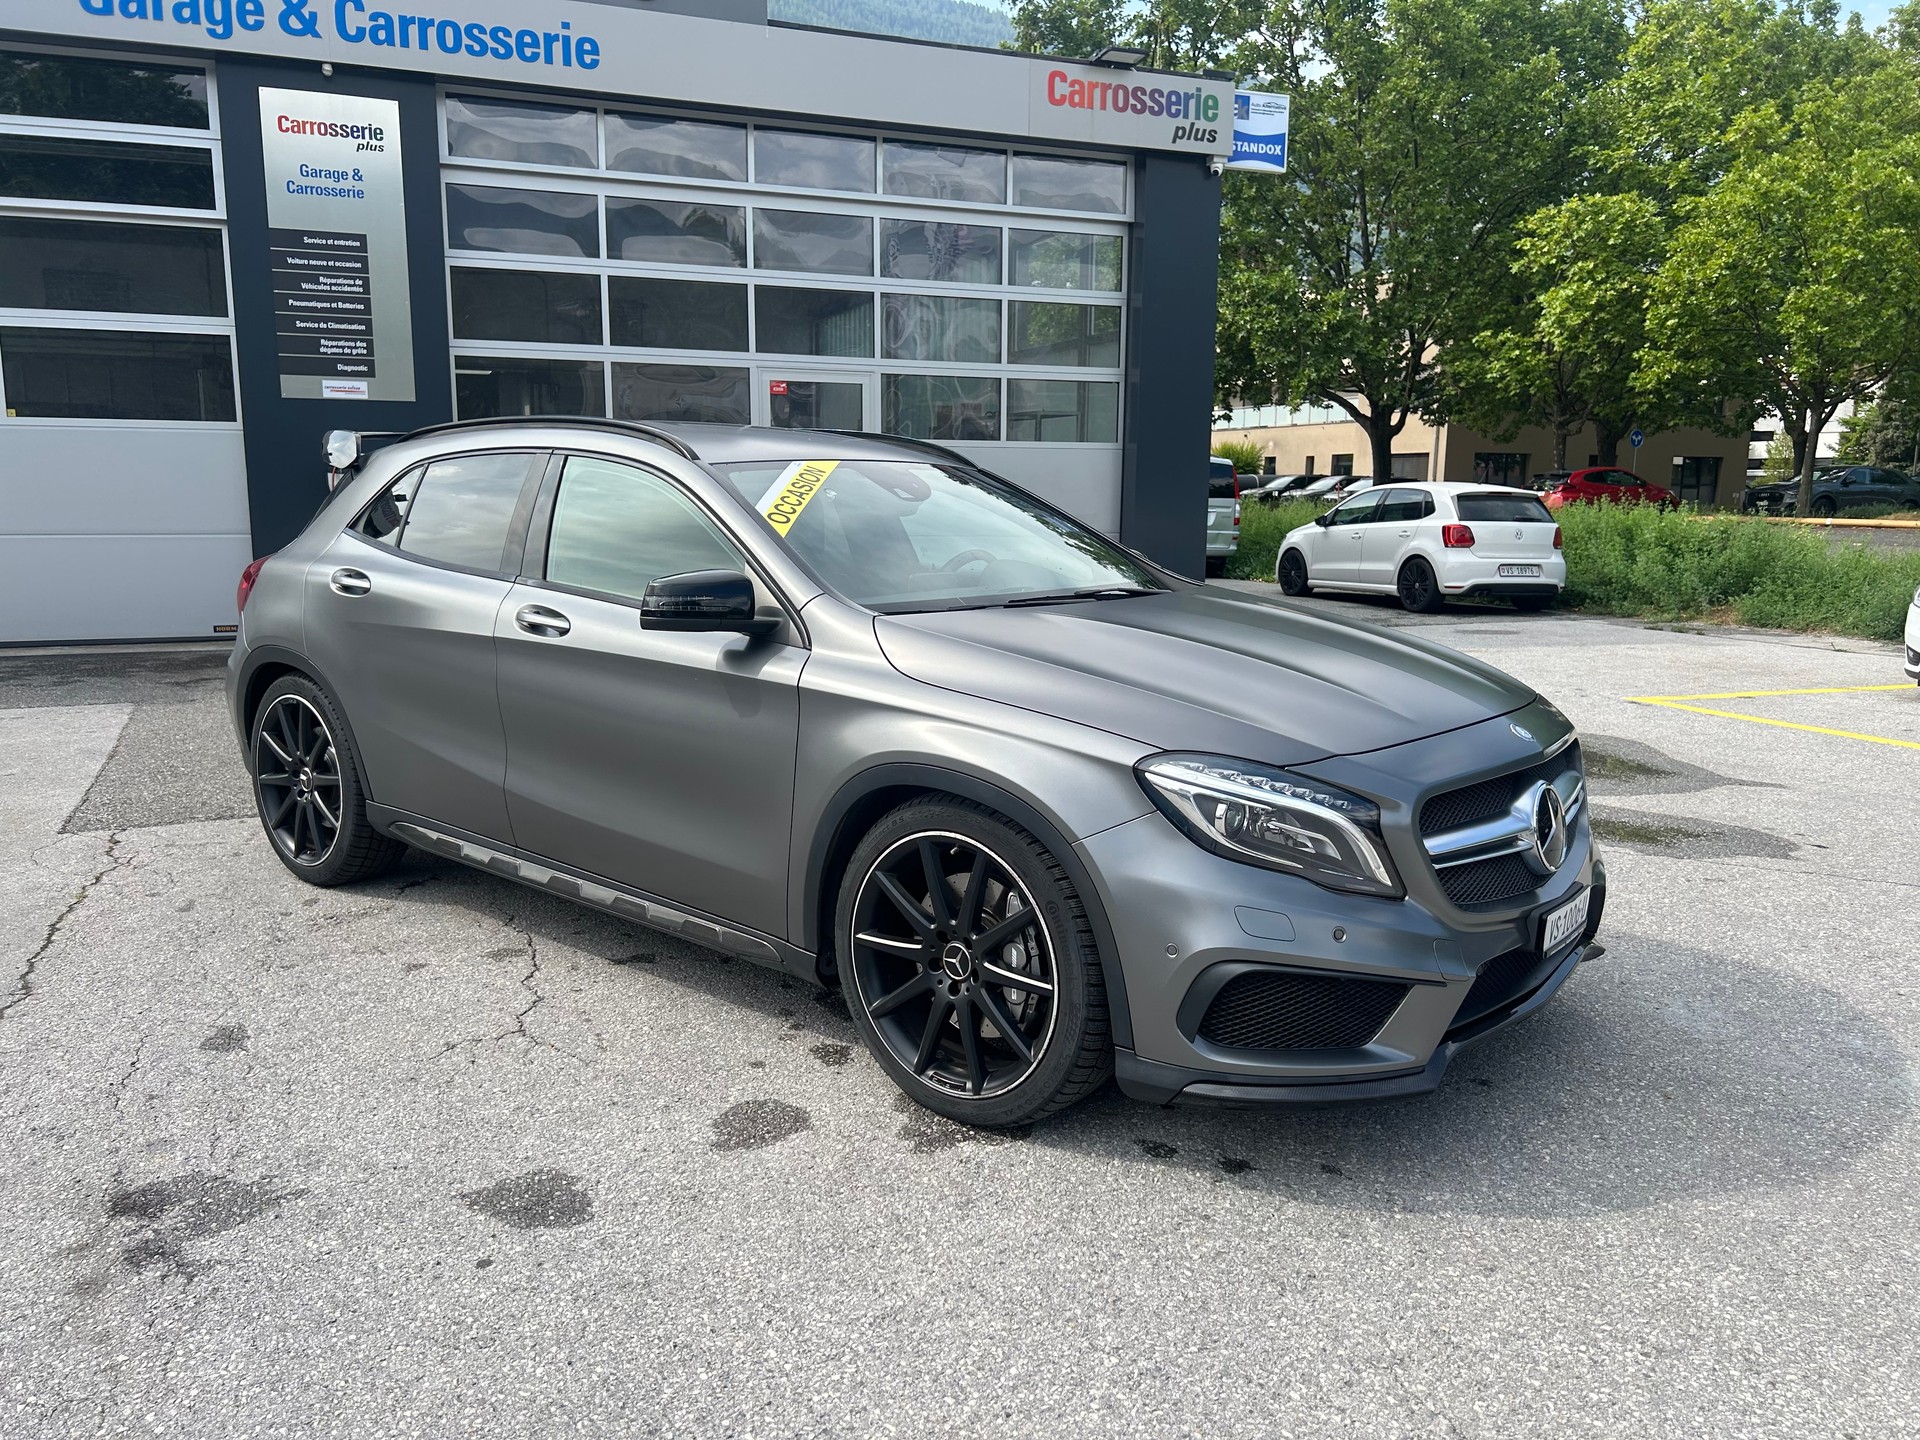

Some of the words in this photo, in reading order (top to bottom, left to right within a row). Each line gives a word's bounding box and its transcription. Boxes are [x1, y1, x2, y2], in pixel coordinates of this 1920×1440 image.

[277, 0, 322, 39] &
[335, 0, 600, 70] Carrosserie
[1047, 69, 1219, 123] Carrosserie
[277, 115, 384, 141] Carrosserie
[1171, 122, 1218, 144] plus
[356, 141, 385, 152] plus
[300, 163, 348, 182] Garage
[352, 168, 363, 182] &
[286, 180, 365, 199] Carrosserie
[303, 236, 326, 244] Service
[286, 257, 308, 265] Voiture
[319, 276, 354, 285] Réparations
[301, 282, 330, 291] Véhicules
[288, 299, 330, 309] Pneumatiques
[338, 301, 365, 310] Batteries
[296, 320, 318, 328] Service
[328, 322, 366, 330] Climatisation
[320, 338, 355, 347] Réparations
[337, 363, 369, 372] Diagnostic
[767, 465, 826, 524] OCCASION
